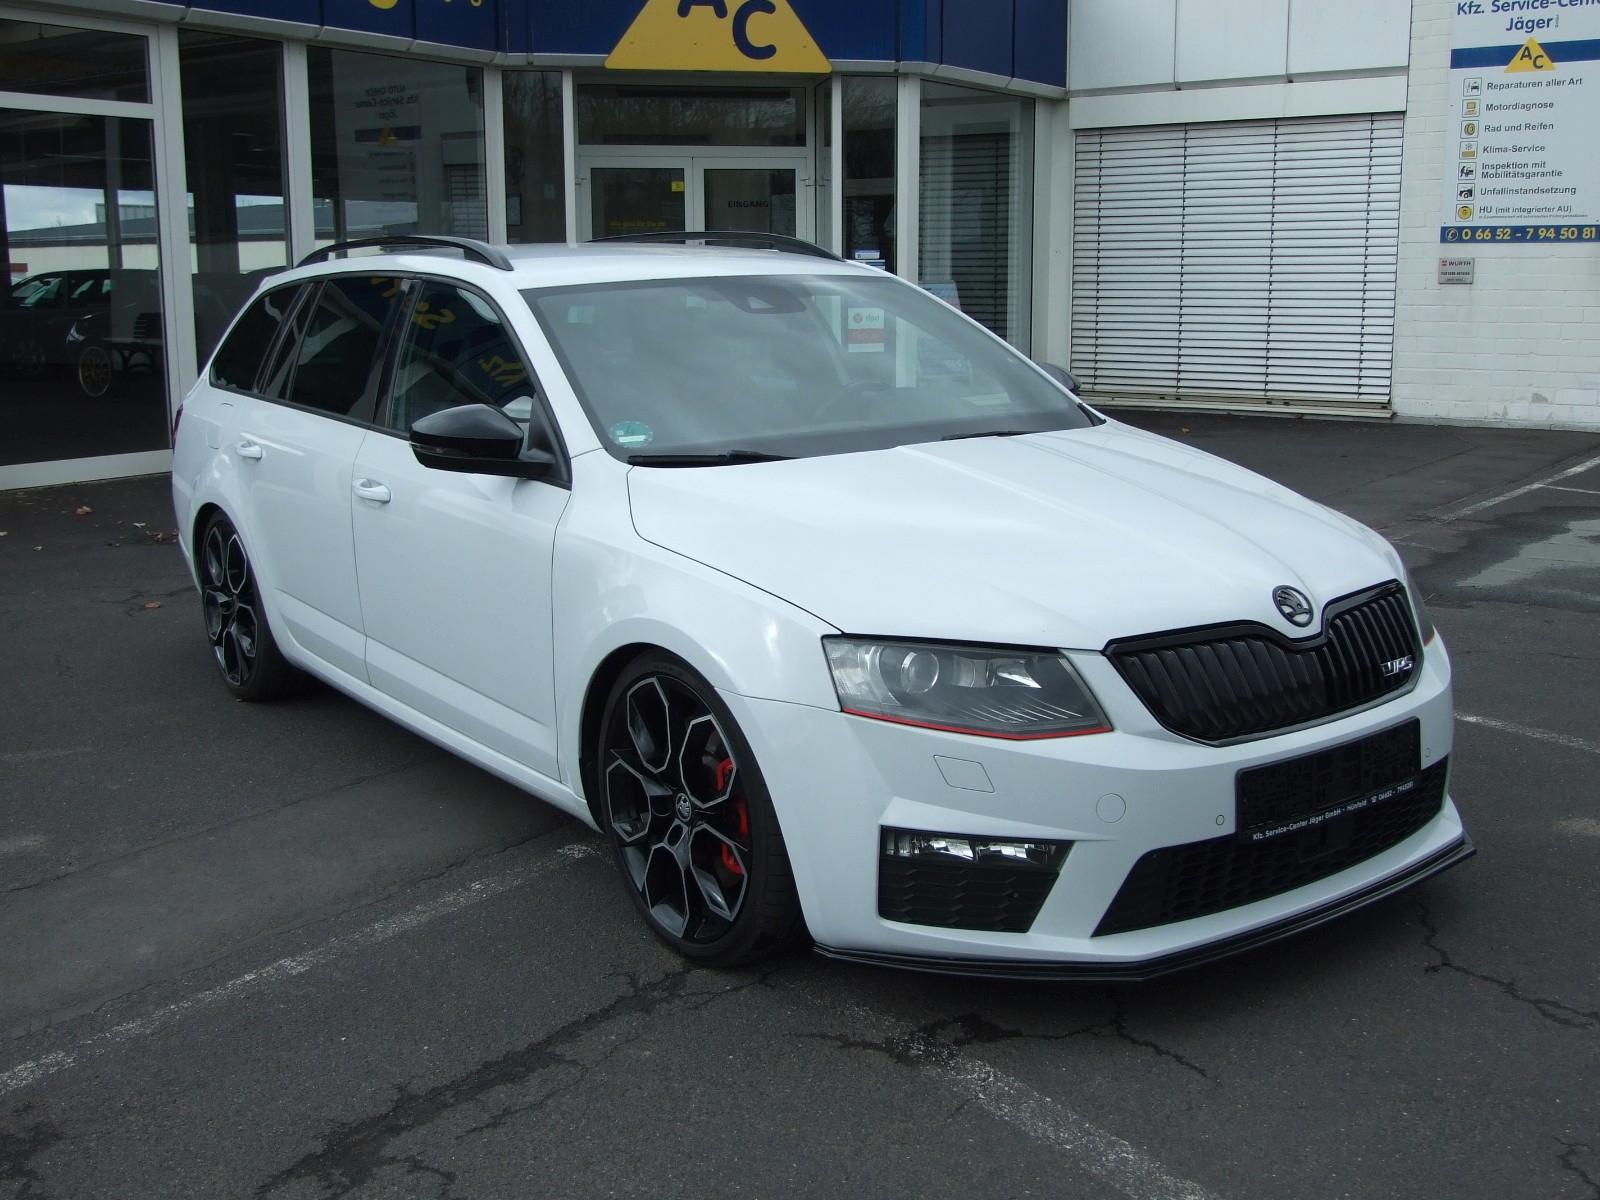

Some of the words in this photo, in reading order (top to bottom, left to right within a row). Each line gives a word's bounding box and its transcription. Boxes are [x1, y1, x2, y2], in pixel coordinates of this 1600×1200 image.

[1457, 2, 1485, 15] Kfz.
[1505, 16, 1553, 33] Jäger
[1519, 46, 1544, 69] AC
[1487, 79, 1543, 91] Reparaturen
[1545, 78, 1566, 87] aller
[1568, 77, 1583, 86] Art
[1485, 101, 1554, 112] Motordiagnose
[1484, 124, 1502, 133] Rad
[1504, 123, 1522, 132] und
[1524, 121, 1554, 131] Reifen
[1482, 144, 1546, 154] Klima-Service
[1481, 161, 1529, 172] Inspektion
[1531, 161, 1546, 169] mit
[1481, 169, 1563, 180] Mobilitätsgarantie
[1480, 186, 1577, 196] Unfallinstandsetzung
[1479, 206, 1493, 214] HU
[1495, 206, 1510, 215] (mit
[1557, 205, 1572, 213] AU)
[1462, 228, 1472, 240] 0
[1475, 229, 1492, 240] 66
[1495, 228, 1511, 240] 52
[1526, 228, 1534, 239] 7
[1538, 228, 1556, 239] 94
[1559, 227, 1578, 239] 50
[1582, 227, 1597, 239] 81
